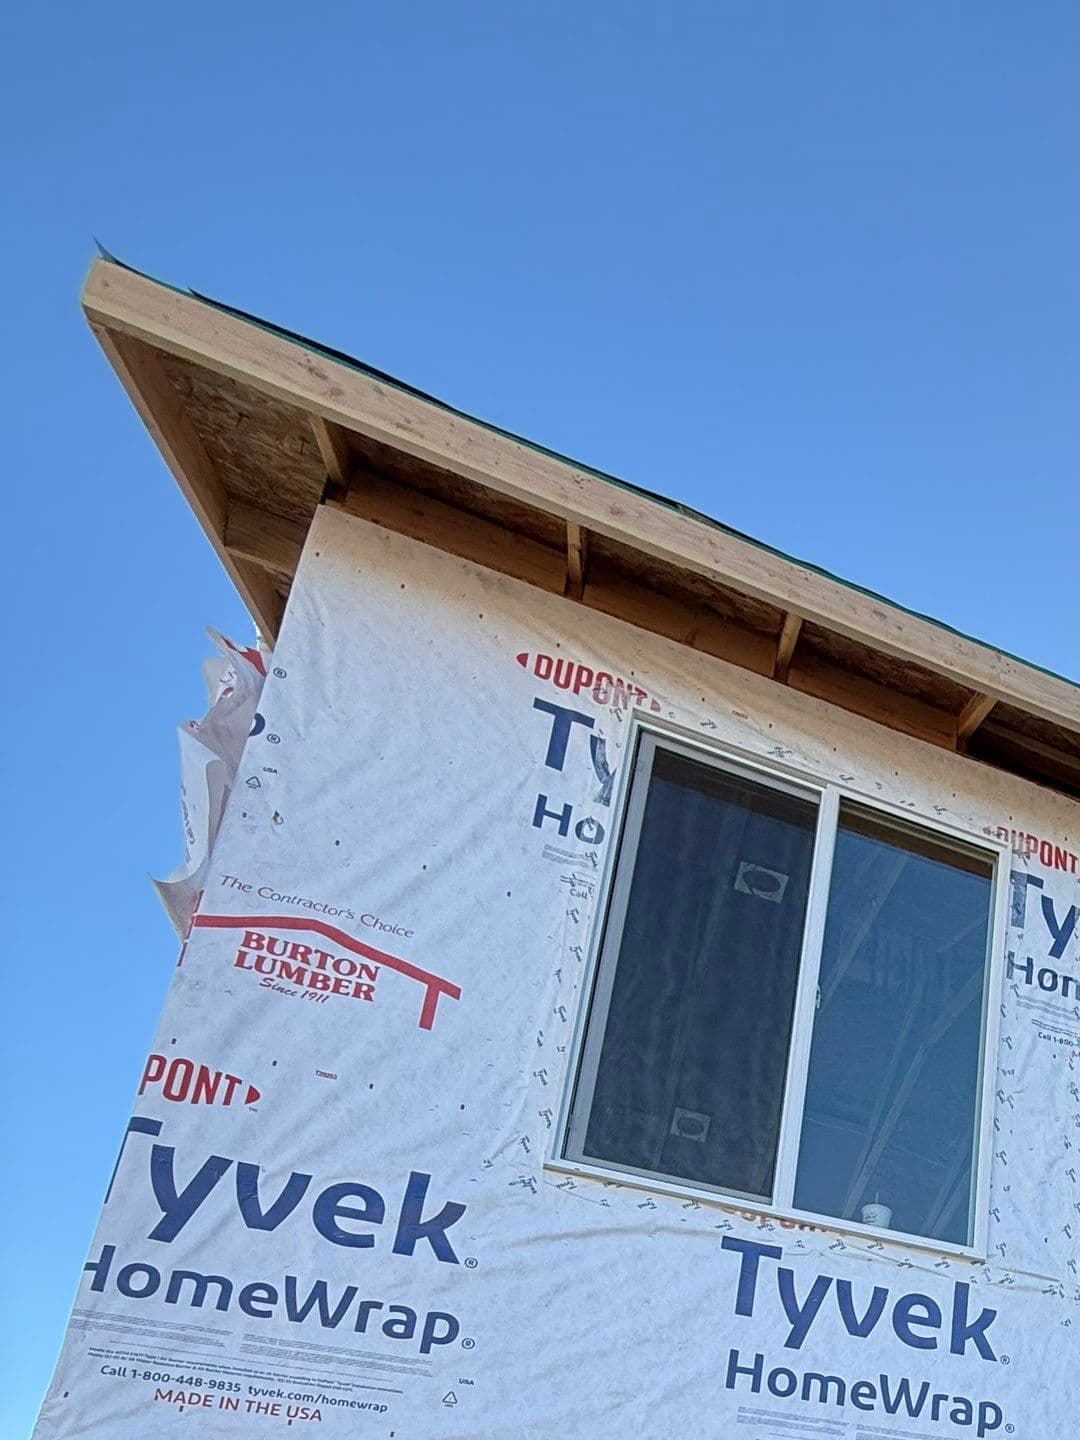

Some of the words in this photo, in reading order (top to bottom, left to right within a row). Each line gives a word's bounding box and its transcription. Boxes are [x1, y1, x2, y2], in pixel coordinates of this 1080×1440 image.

[218, 873, 253, 893] The
[257, 886, 355, 920] Contractor's
[360, 913, 415, 938] Choice
[234, 950, 376, 1003] LUMBER
[240, 930, 381, 982] BURTON
[258, 977, 299, 998] Since
[300, 989, 331, 1005] 1911
[100, 1365, 128, 1378] Call
[131, 1368, 241, 1392] 1-800-448-9835
[248, 1386, 388, 1413] tyvek.com/homewrap
[154, 1387, 214, 1409] MADE
[219, 1396, 239, 1411] IN
[245, 1399, 280, 1417] THE
[286, 1405, 323, 1422] USA
